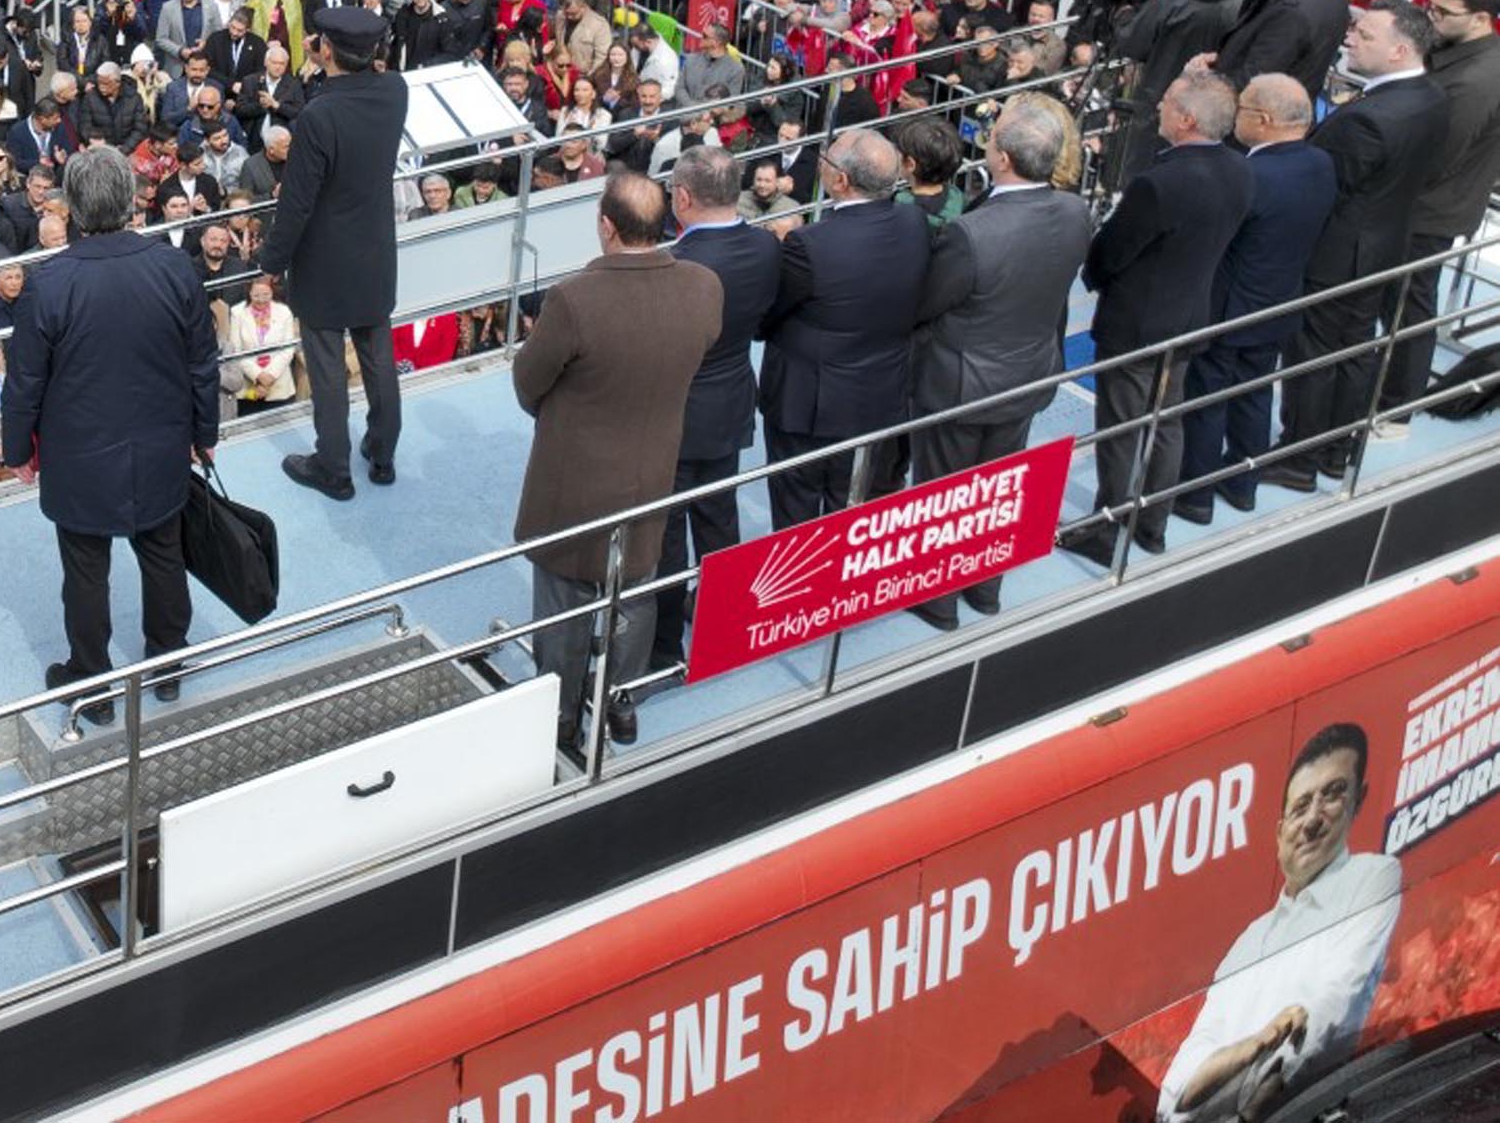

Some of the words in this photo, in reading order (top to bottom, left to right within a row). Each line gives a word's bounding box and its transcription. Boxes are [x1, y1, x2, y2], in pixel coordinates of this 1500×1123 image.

[841, 537, 914, 581] HALK
[921, 492, 1023, 555] PARTİSİ
[847, 464, 1030, 546] CUMHURİYET
[746, 590, 870, 650] Türkiye'nin
[874, 560, 942, 606] Birinci
[948, 534, 1016, 581] Partisi
[783, 877, 992, 1053] SAHİP
[1008, 762, 1255, 967] ÇIKIYOR
